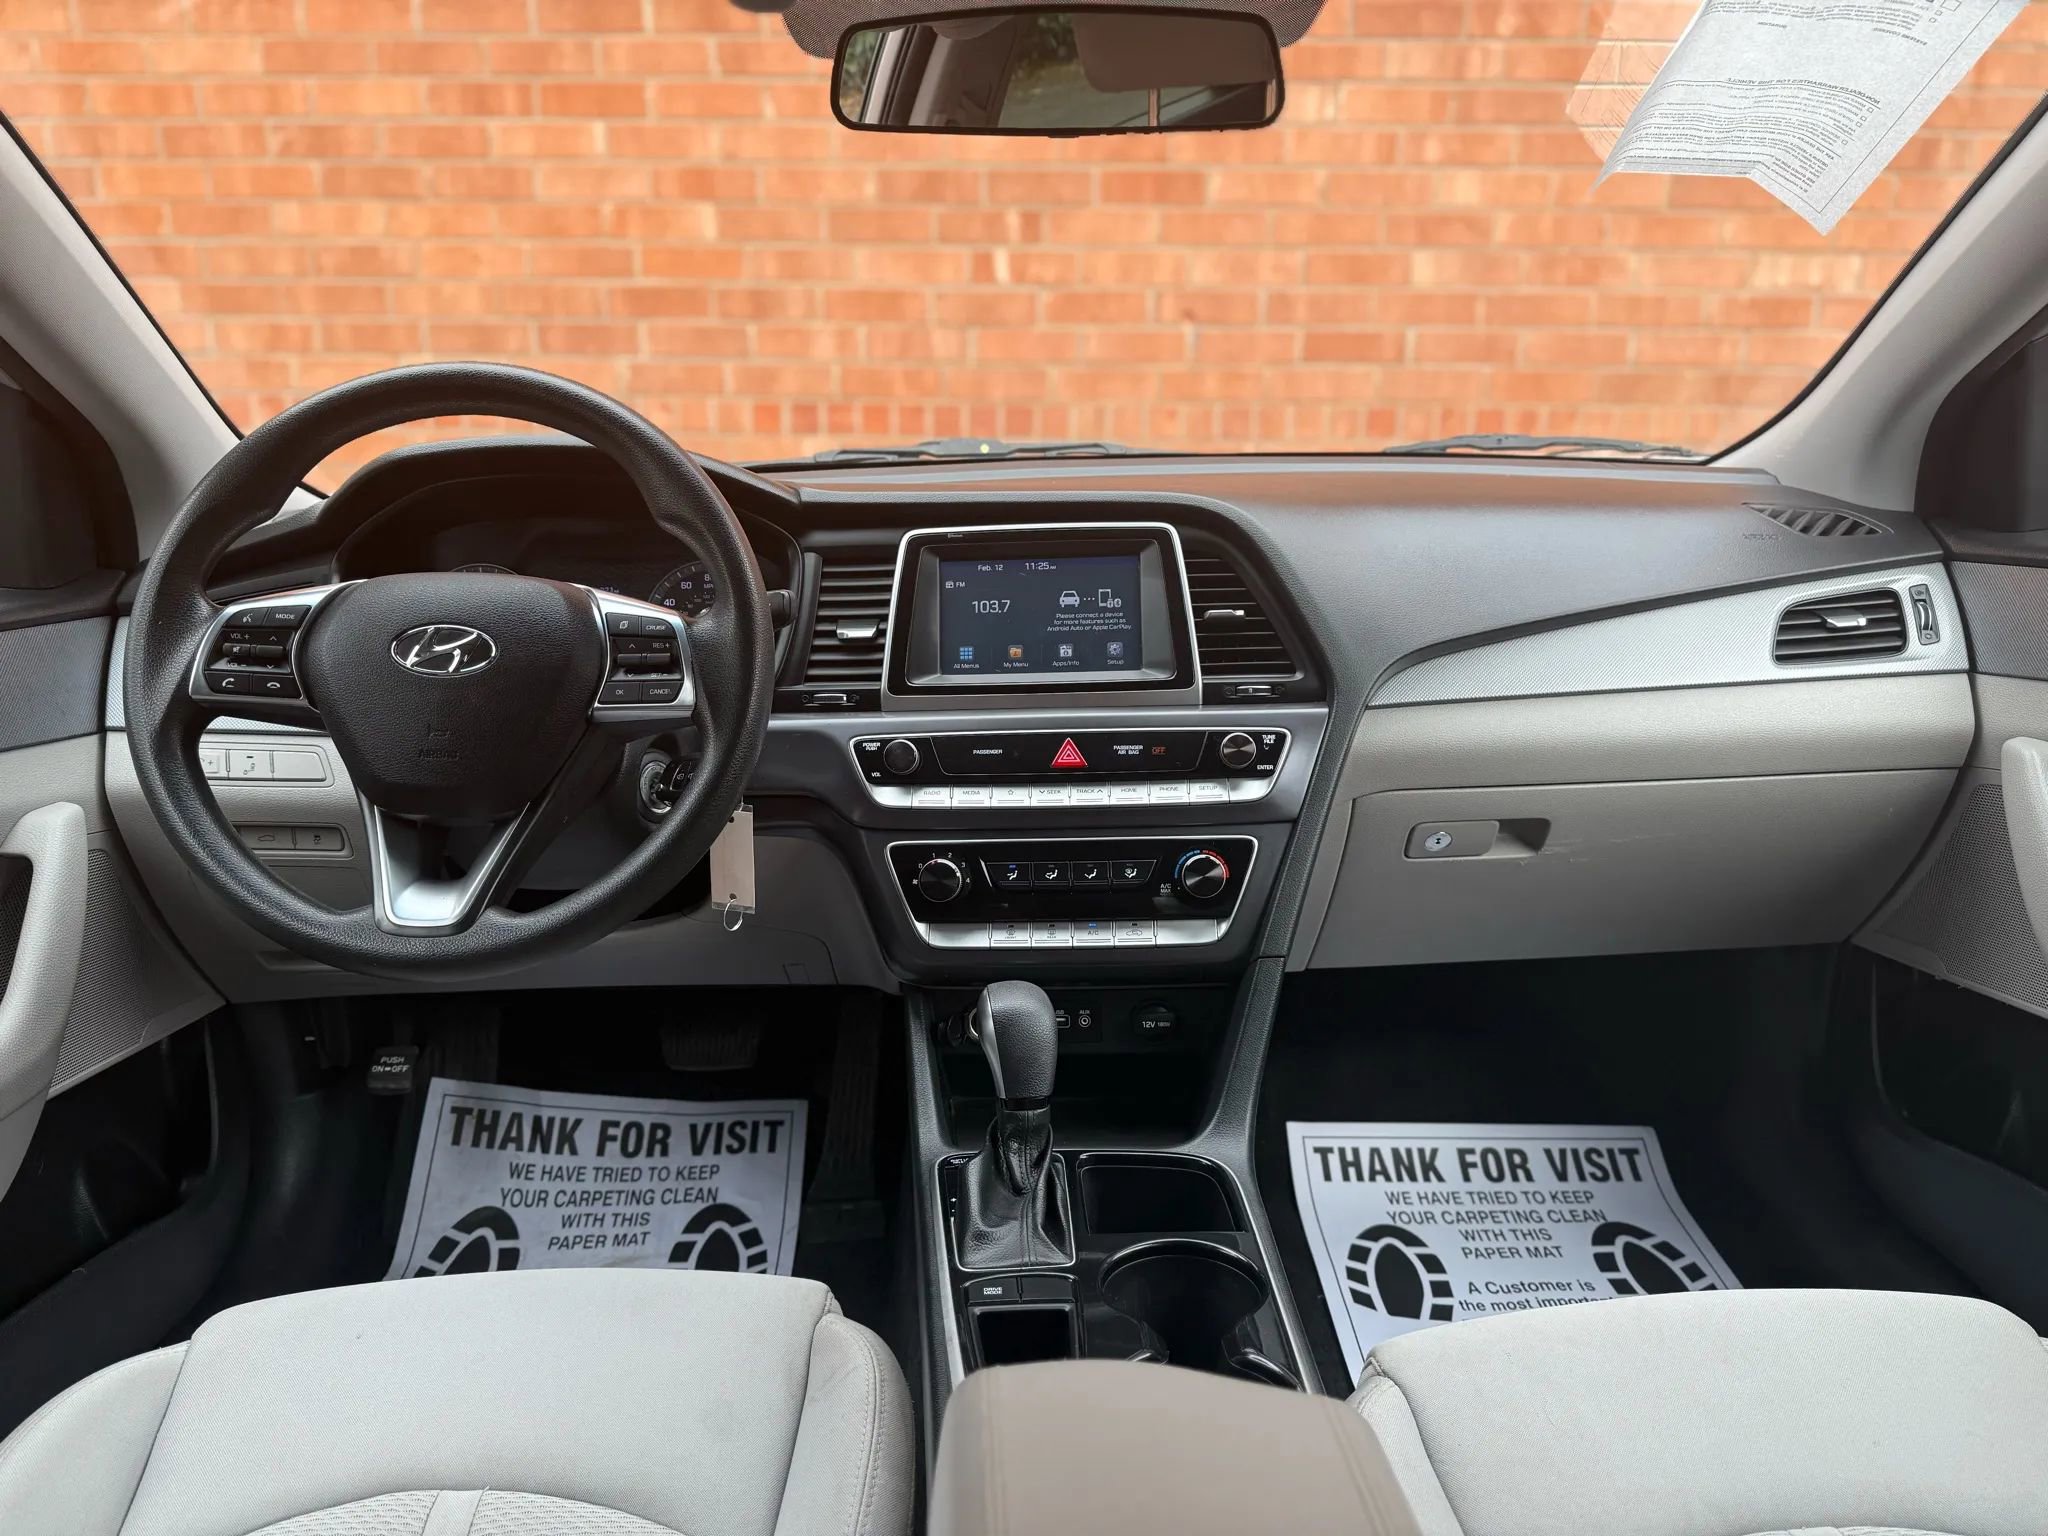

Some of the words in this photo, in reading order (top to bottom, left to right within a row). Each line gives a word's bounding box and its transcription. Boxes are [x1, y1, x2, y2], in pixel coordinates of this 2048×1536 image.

[1025, 562, 1049, 570] 11:25
[972, 600, 1011, 613] 103.7
[449, 1105, 585, 1157] THANK
[596, 1120, 673, 1159] FOR
[689, 1118, 786, 1156] VISIT
[1313, 1145, 1446, 1183] THANK
[1457, 1147, 1535, 1183] FOR
[1542, 1147, 1646, 1183] VISIT
[508, 1163, 535, 1181] WE
[540, 1164, 588, 1183] HAVE
[592, 1166, 643, 1184] TRIED
[648, 1166, 673, 1183] TO
[675, 1165, 720, 1182] KEEP
[500, 1188, 550, 1209] YOUR
[553, 1187, 655, 1208] CARPETING
[660, 1187, 720, 1205] CLEAN
[1385, 1190, 1412, 1206] WE
[1417, 1190, 1462, 1206] HAVE
[1465, 1190, 1518, 1206] TRIED
[1522, 1190, 1548, 1205] TO
[1551, 1190, 1595, 1205] KEEP
[561, 1212, 604, 1229] WITH
[610, 1211, 651, 1227] THIS
[1387, 1210, 1437, 1226] YOUR
[1441, 1209, 1543, 1225] CARPETING
[1547, 1208, 1607, 1223] CLEAN
[547, 1234, 608, 1252] PAPER
[612, 1231, 652, 1248] MAT
[1459, 1229, 1506, 1243] WITH
[1511, 1228, 1553, 1242] THIS
[1461, 1246, 1523, 1261] PAPER
[1528, 1245, 1564, 1259] MAT
[1468, 1281, 1481, 1295] A
[1485, 1279, 1573, 1294] Customer
[1577, 1279, 1596, 1292] is
[1459, 1299, 1486, 1312] the
[1490, 1297, 1535, 1312] most
